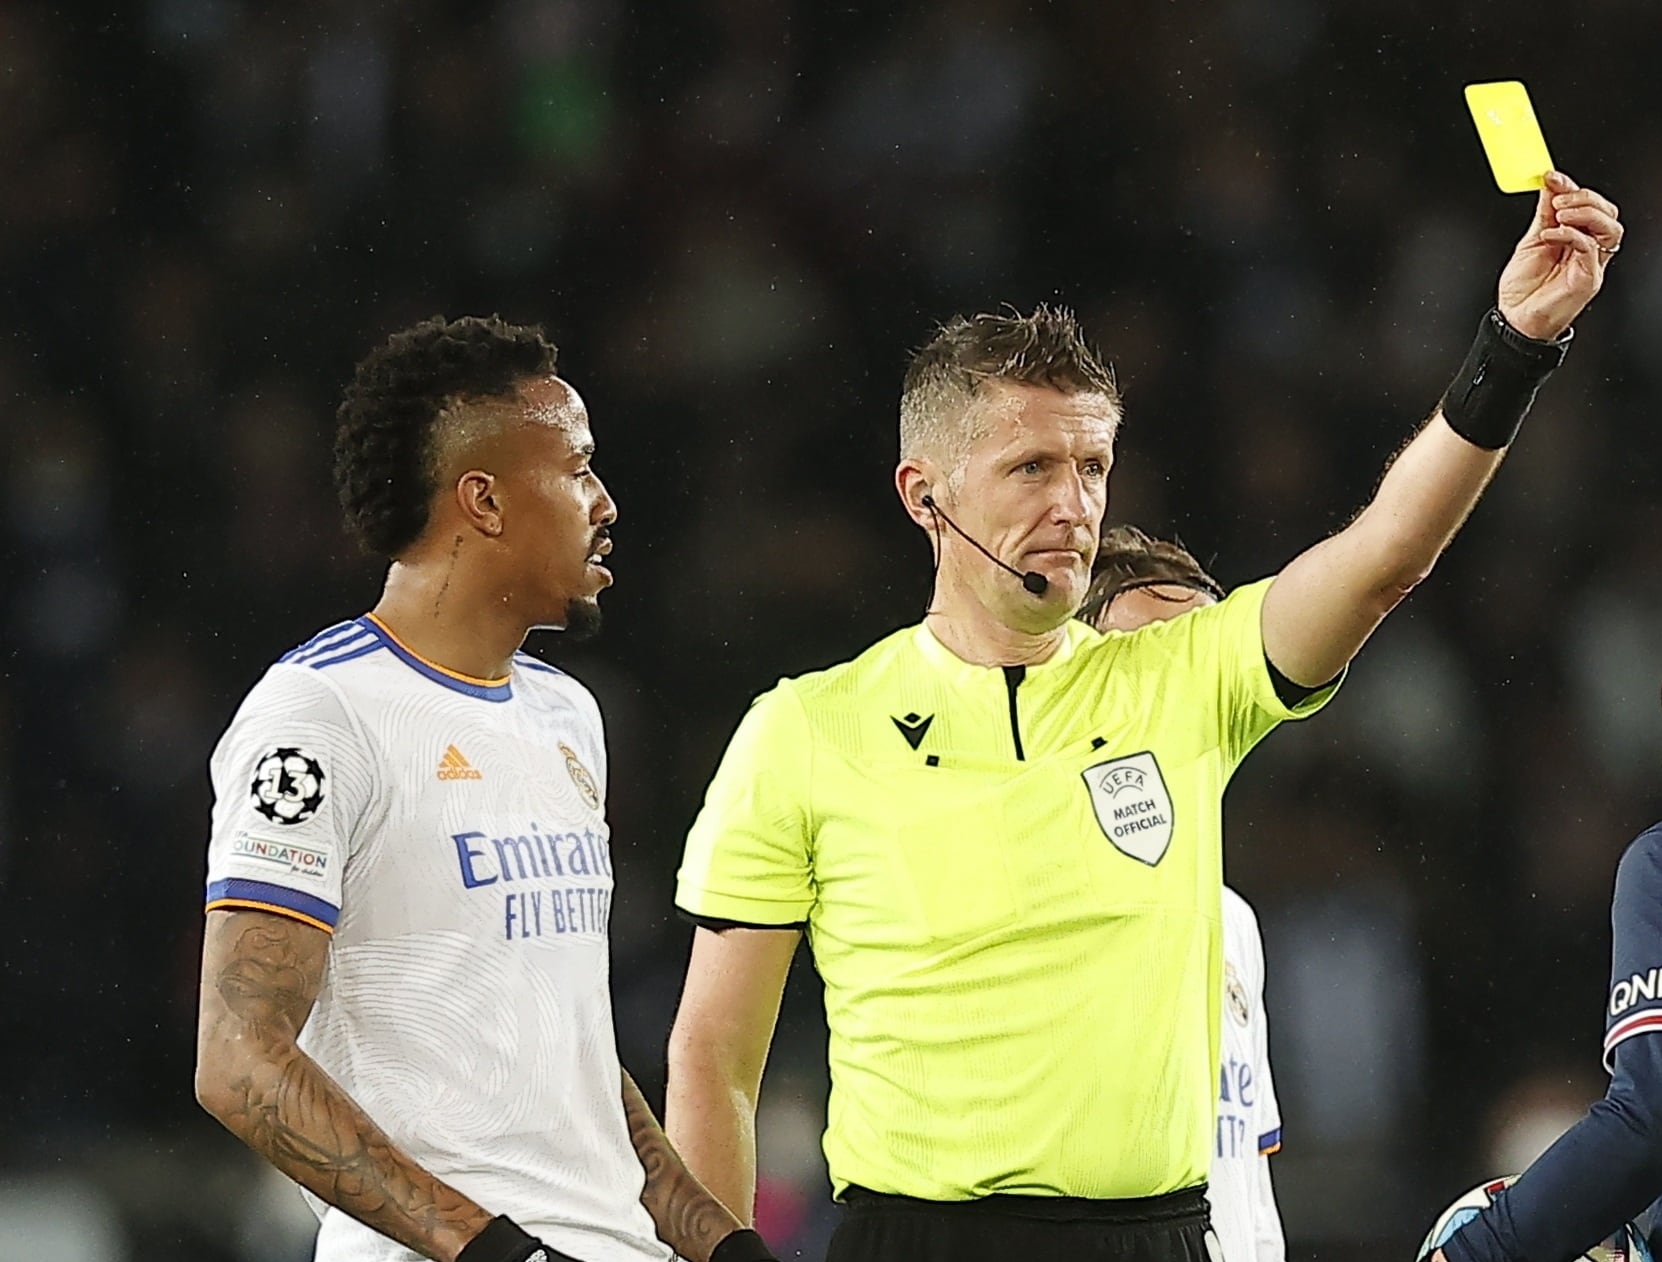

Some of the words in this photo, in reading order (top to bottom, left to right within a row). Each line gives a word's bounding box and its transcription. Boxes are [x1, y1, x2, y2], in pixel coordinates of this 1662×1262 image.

[264, 767, 308, 803] 13
[1103, 771, 1144, 795] UEFA
[1113, 799, 1156, 820] MATCH
[1114, 814, 1167, 837] OFFICIAL
[506, 891, 541, 940] FLY
